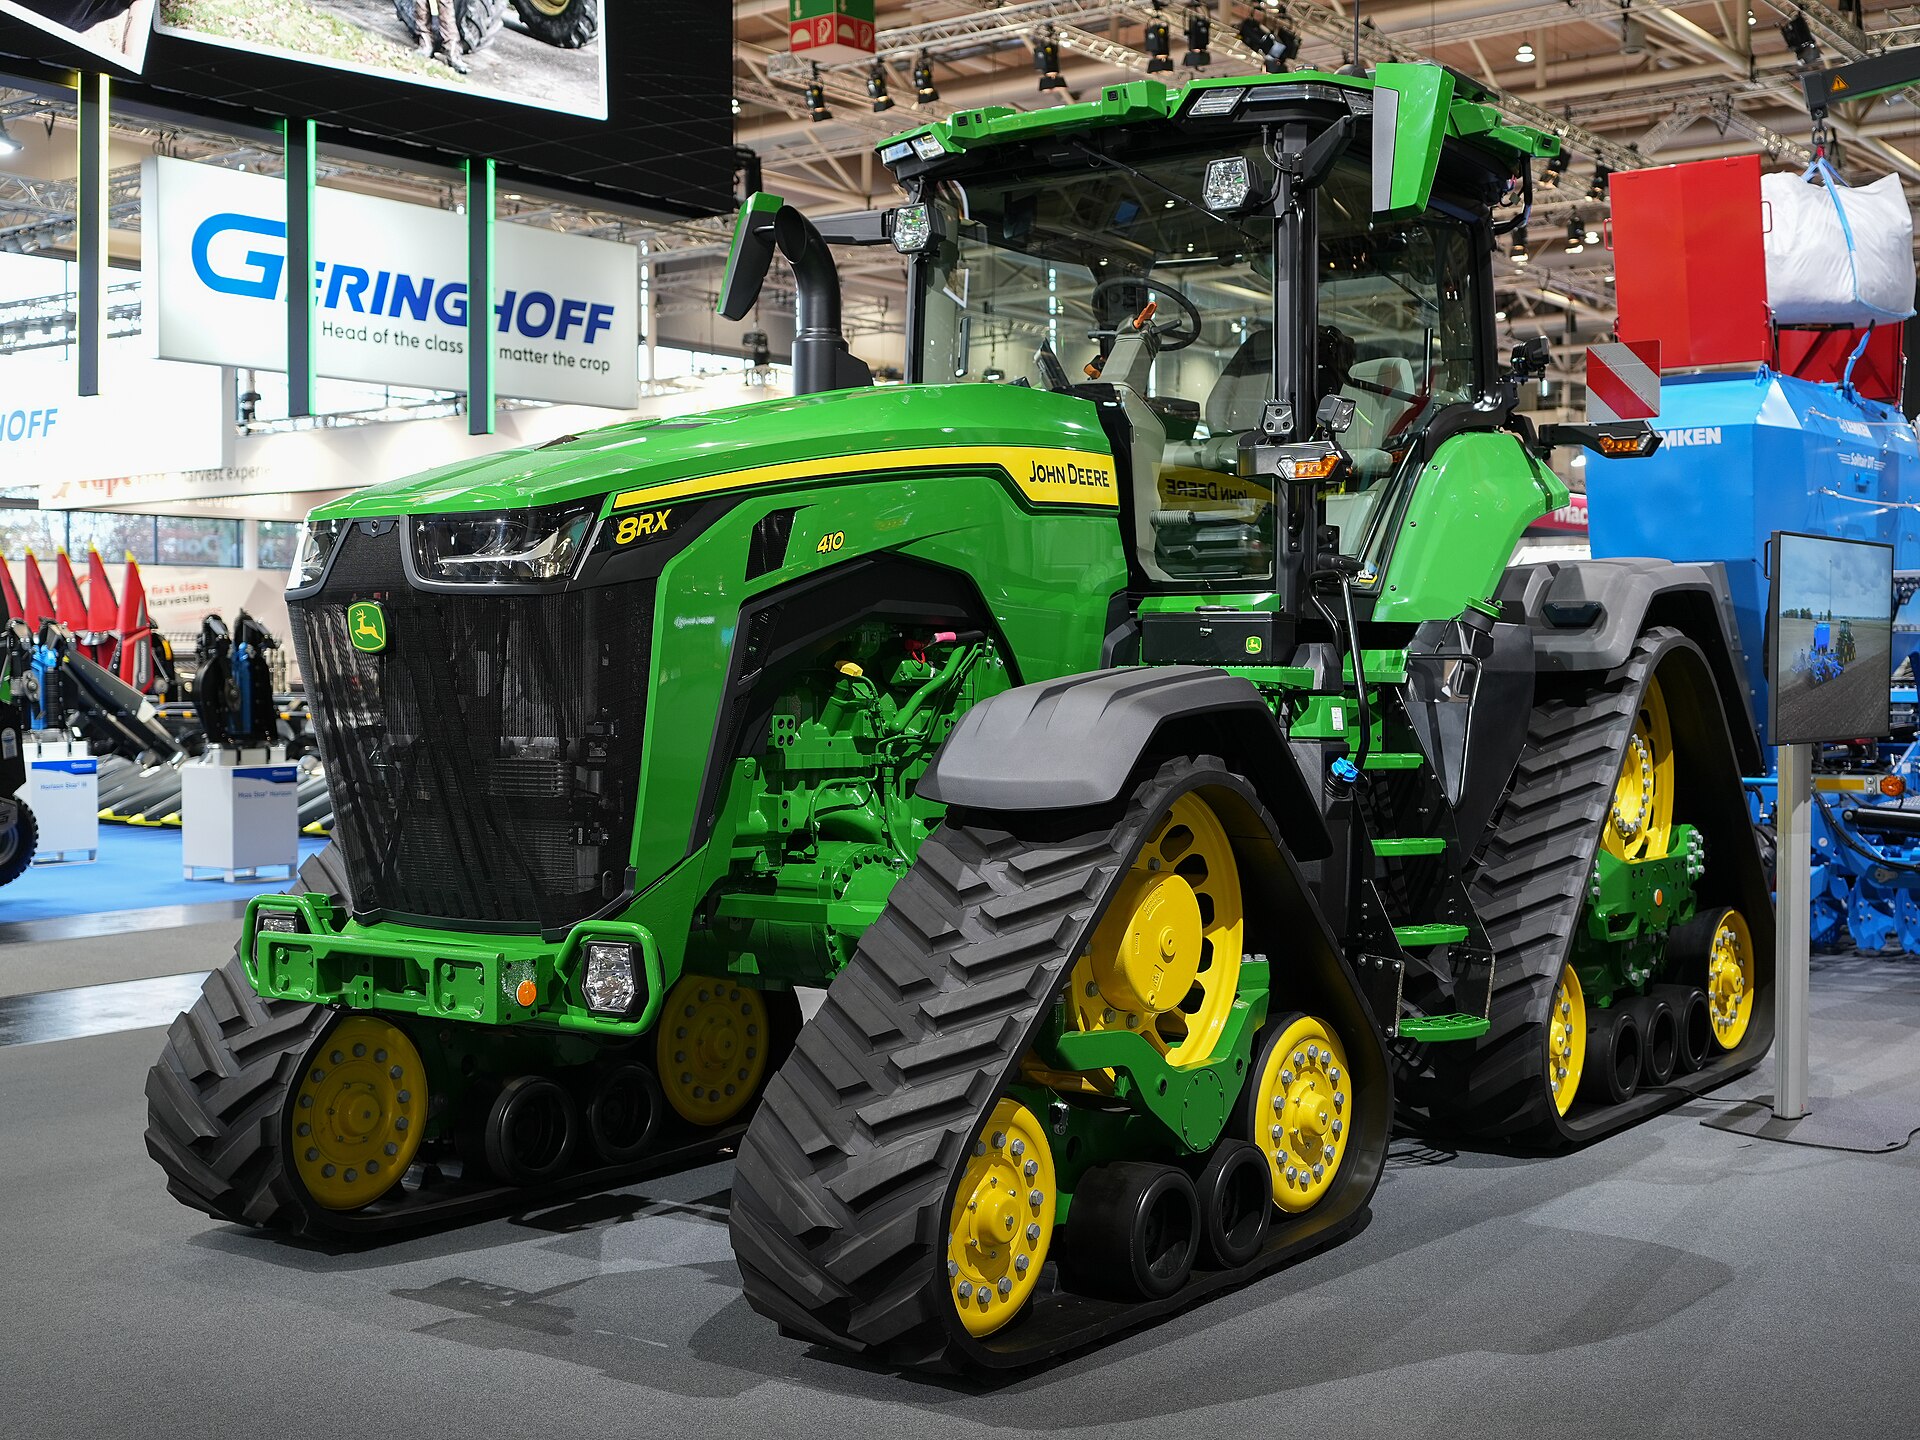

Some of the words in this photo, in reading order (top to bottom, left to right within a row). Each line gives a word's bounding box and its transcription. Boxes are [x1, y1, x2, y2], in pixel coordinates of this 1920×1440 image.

[322, 320, 367, 342] Head
[373, 329, 389, 344] of
[394, 331, 420, 348] the
[425, 334, 463, 353] class
[499, 346, 548, 364] matter
[553, 351, 576, 367] the
[580, 357, 610, 374] crop
[1029, 460, 1066, 484] JOHN
[1067, 463, 1110, 488] DEERE
[615, 508, 672, 545] 8RX
[816, 530, 846, 554] 410
[149, 593, 210, 607] harvesting
[151, 584, 175, 595] first
[179, 581, 209, 593] class
